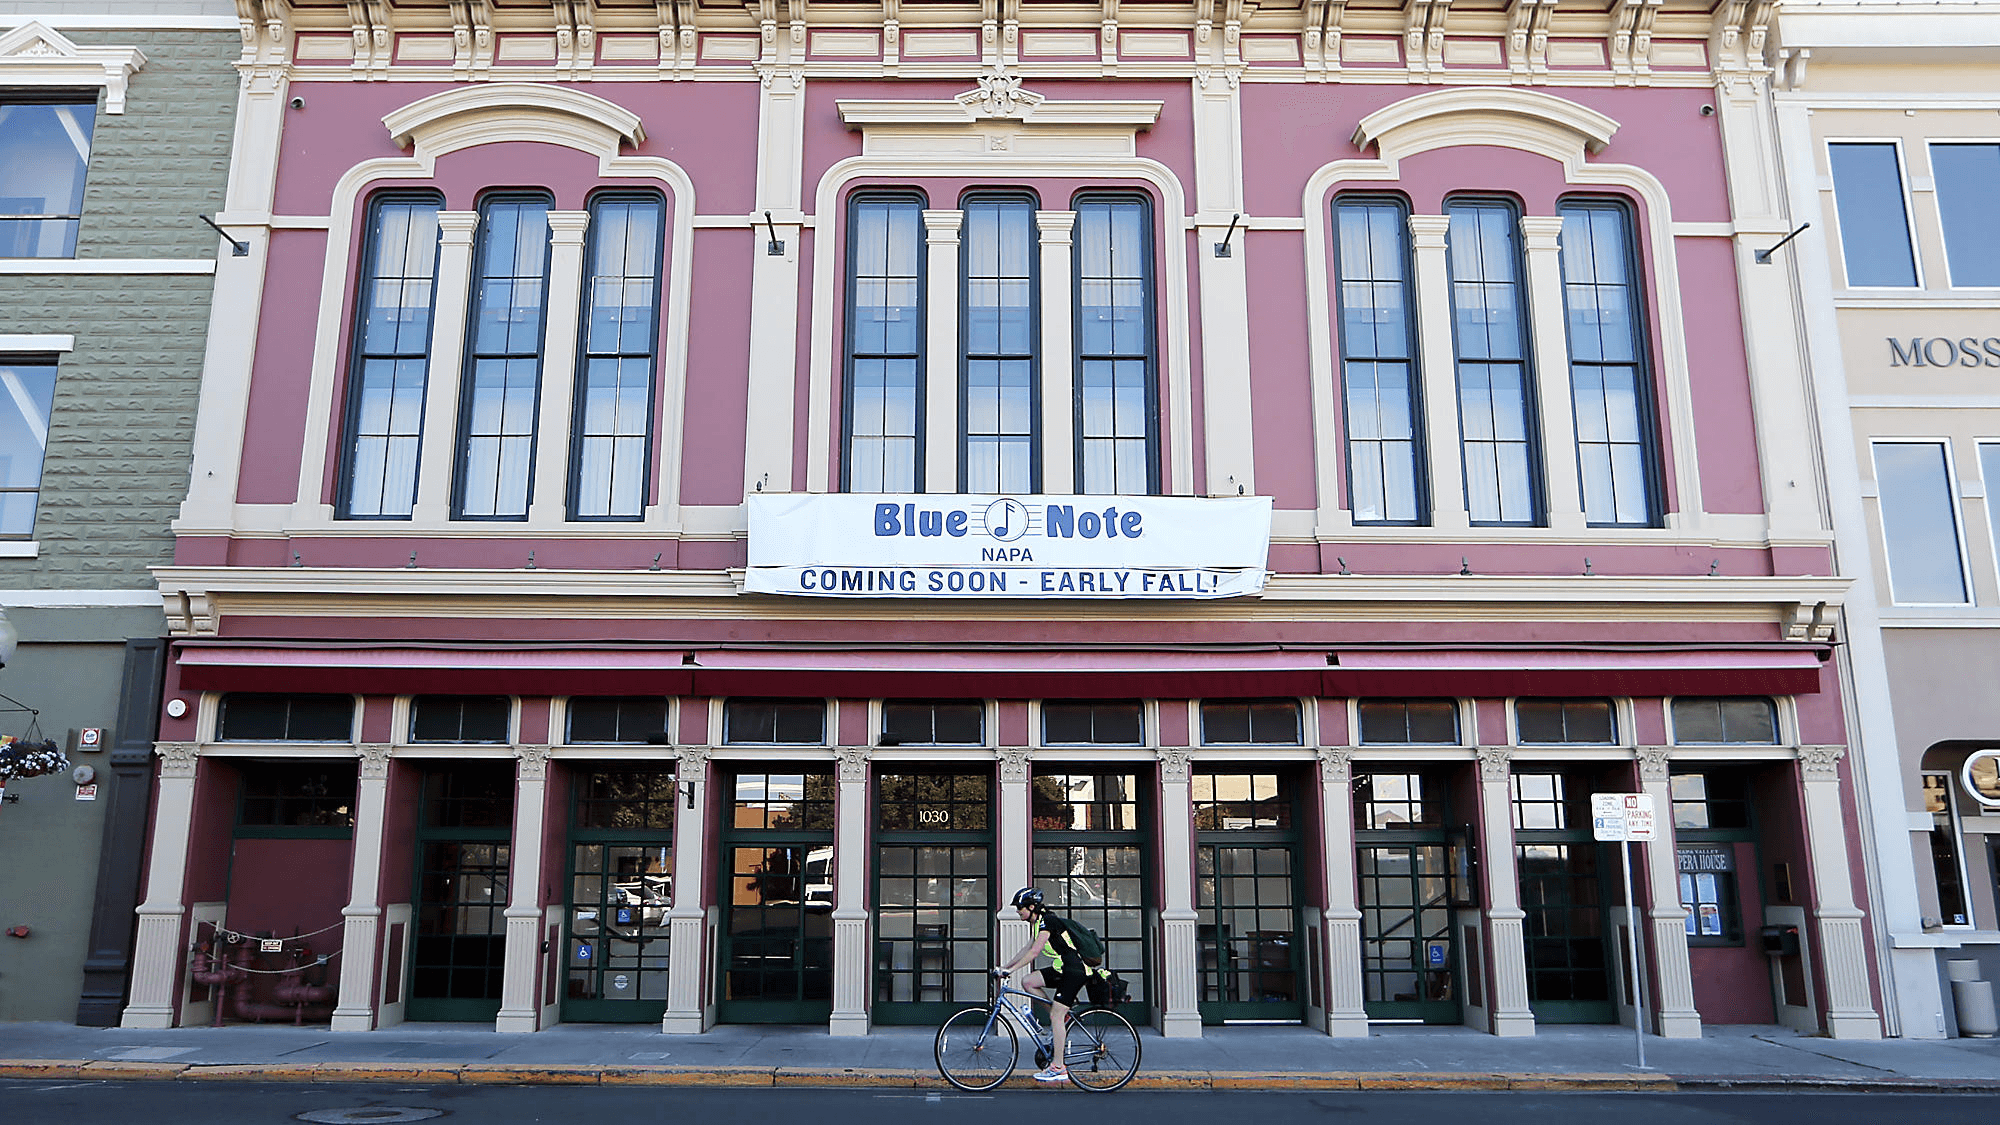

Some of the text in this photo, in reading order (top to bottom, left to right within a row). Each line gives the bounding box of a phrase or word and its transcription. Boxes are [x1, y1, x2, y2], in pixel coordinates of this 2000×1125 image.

[1886, 337, 2000, 368] MOSS
[874, 503, 1143, 539] Blue Note
[981, 548, 1034, 562] NAPA
[800, 569, 916, 591] COMING
[928, 571, 1006, 592] SOON
[1041, 571, 1130, 592] EARLY
[1142, 572, 1218, 593] FALL!
[1626, 797, 1637, 808] NO
[919, 810, 949, 823] 1030
[1627, 810, 1652, 819] PARKING
[1596, 819, 1603, 828] 2
[1678, 854, 1727, 870] PERA HOUSE
